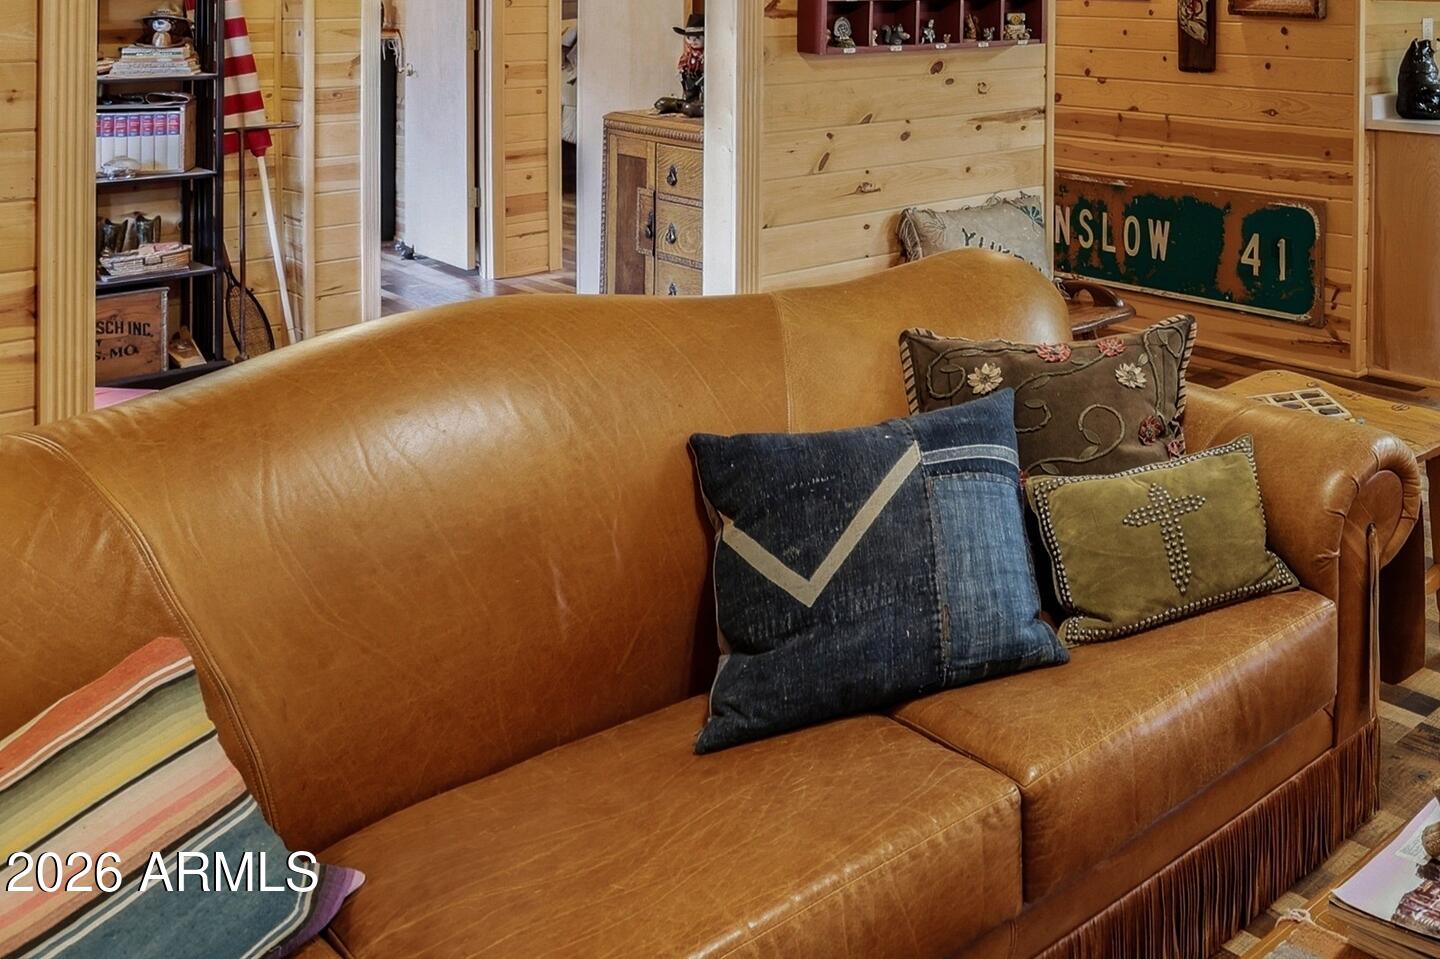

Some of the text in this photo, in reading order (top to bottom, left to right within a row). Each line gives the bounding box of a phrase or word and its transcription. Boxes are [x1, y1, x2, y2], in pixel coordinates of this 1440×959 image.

[1054, 204, 1171, 262] NSLOW
[1240, 232, 1286, 282] 41
[127, 321, 154, 338] INC.
